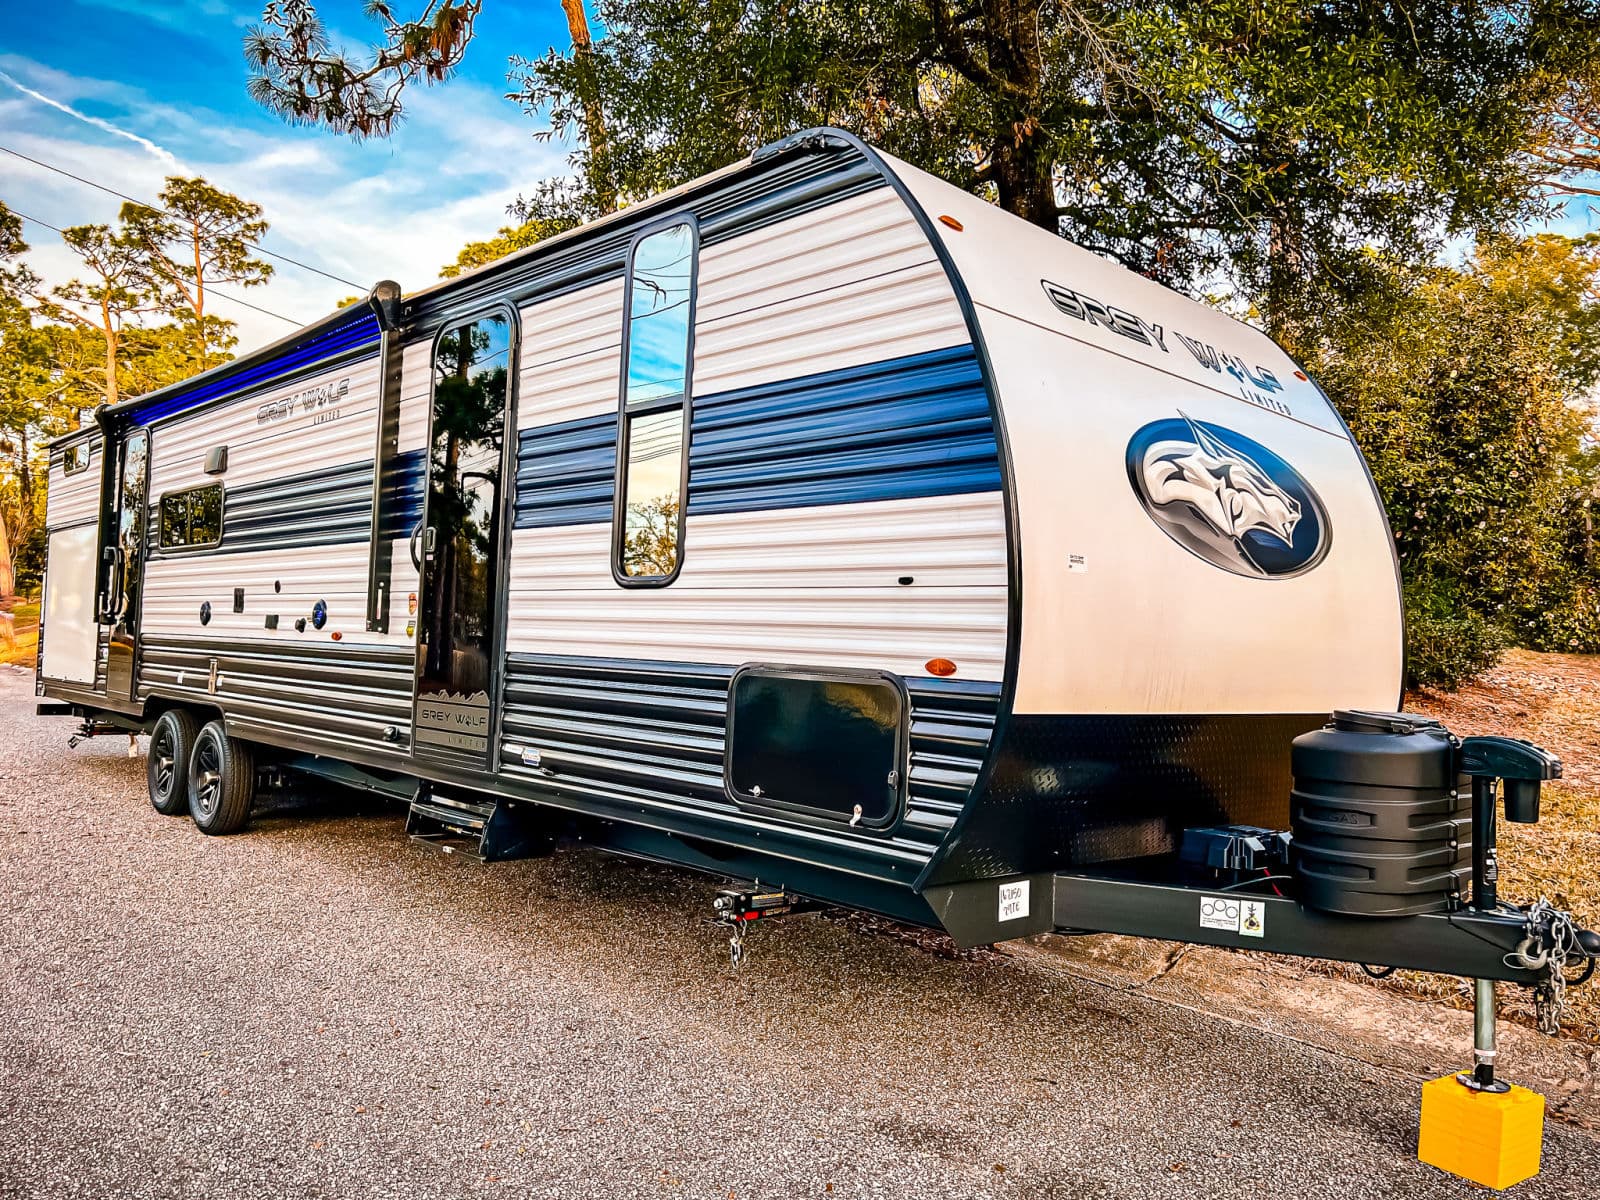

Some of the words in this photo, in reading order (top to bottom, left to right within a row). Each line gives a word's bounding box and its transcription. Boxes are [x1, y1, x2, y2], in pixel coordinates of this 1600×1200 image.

[1040, 279, 1169, 353] GREY
[256, 392, 299, 425] GREY
[1239, 387, 1292, 416] LIMITED
[422, 709, 451, 722] GREY
